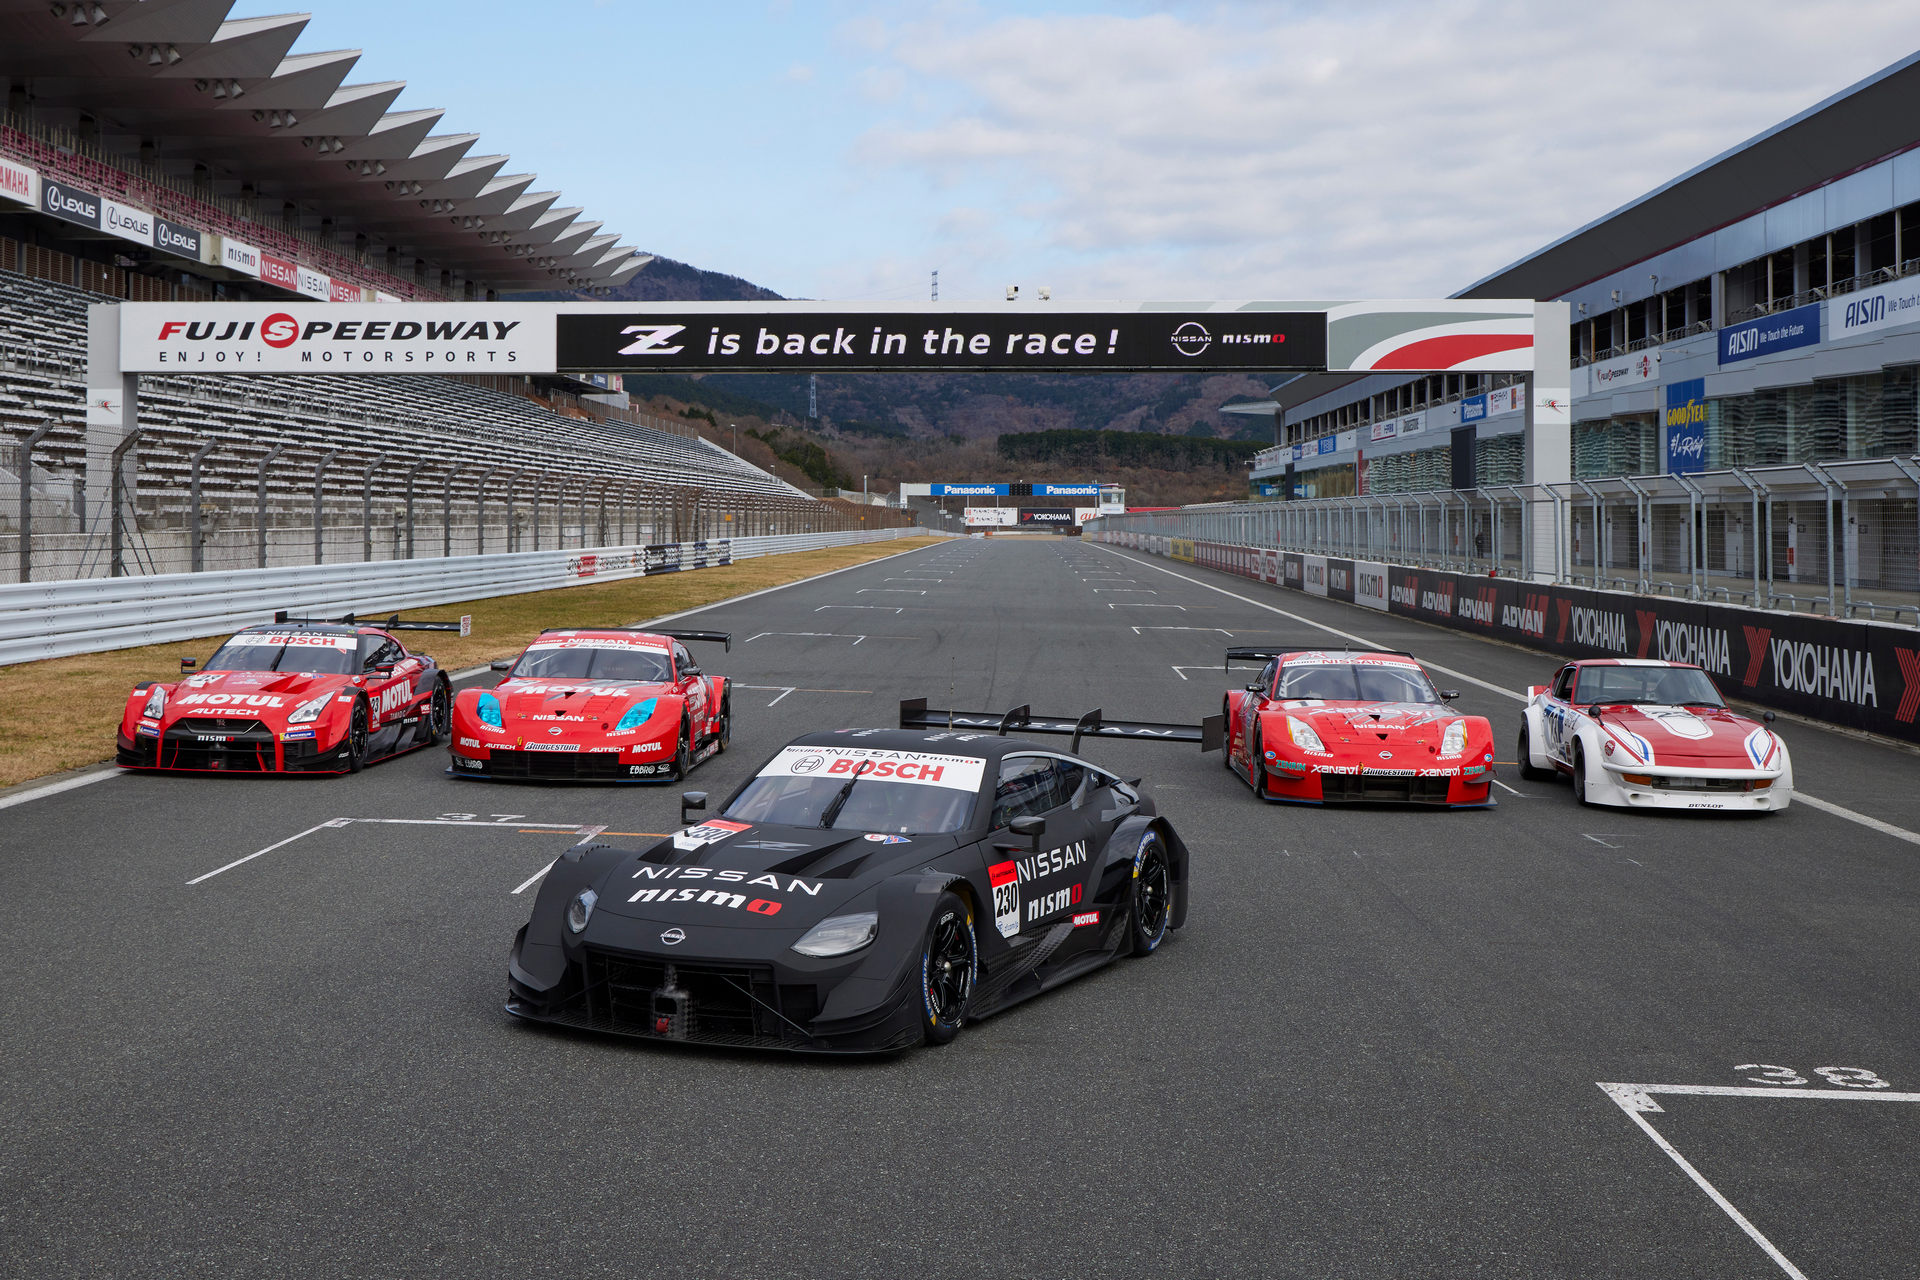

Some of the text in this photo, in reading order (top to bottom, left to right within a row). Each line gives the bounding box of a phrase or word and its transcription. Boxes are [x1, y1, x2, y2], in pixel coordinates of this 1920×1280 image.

[60, 195, 96, 219] LEXUS
[118, 214, 149, 236] LEXUS
[168, 231, 197, 251] LEXUS
[261, 260, 297, 286] NISSAN
[297, 272, 330, 296] NISSAN
[331, 283, 361, 302] NISSAN
[1845, 295, 1885, 328] AISIN
[1899, 293, 1915, 310] Touch
[158, 316, 521, 345] FUJI SPEEDWAY
[708, 328, 739, 355] is
[755, 327, 855, 355] back
[869, 328, 907, 355] in
[924, 328, 991, 355] the
[1222, 334, 1286, 344] nismo
[1728, 327, 1759, 356] AISIN
[1767, 328, 1781, 343] Touch
[1781, 327, 1789, 339] the
[1789, 324, 1805, 338] Future
[159, 350, 518, 363] ENJOY! MOTORSPORTS
[944, 485, 996, 495] Panasonic
[1046, 485, 1098, 495] Panasonic
[1391, 584, 1416, 607] ADVAN
[1422, 590, 1451, 613] ADVAN
[1458, 597, 1493, 623] ADVAN
[1502, 604, 1544, 634] ADVAN
[1571, 605, 1628, 653] YOKOHAMA
[269, 636, 336, 646] BOSCH
[1655, 619, 1731, 676] YOKOHAMA
[1770, 638, 1878, 708] YOKOHAMA
[176, 693, 284, 708] MOTUL
[381, 679, 413, 714] MOTUL
[514, 685, 631, 698] MOTUL
[187, 708, 260, 716] AUTECH
[533, 714, 584, 722] NISSAN
[480, 725, 506, 734] nismo
[460, 737, 481, 748] MOTUL
[484, 742, 516, 750] AUTECH
[525, 742, 581, 752] BRIDGESTONE
[632, 742, 662, 753] MOTUL
[829, 748, 921, 761] NISSAN
[630, 765, 655, 775] EBBRO
[827, 759, 945, 782] BOSCH
[1275, 760, 1306, 772] ZENRIN
[1362, 767, 1416, 777] BRIDGESTONE
[1463, 765, 1486, 776] ZENRIN
[436, 812, 526, 823] 37
[1016, 840, 1087, 885] NISSAN
[632, 866, 824, 897] NISSAN
[626, 888, 783, 917] nismo
[996, 882, 1018, 918] 230
[1027, 882, 1082, 922] nismo
[1073, 913, 1098, 926] MOTUL
[1734, 1063, 1891, 1088] 38
